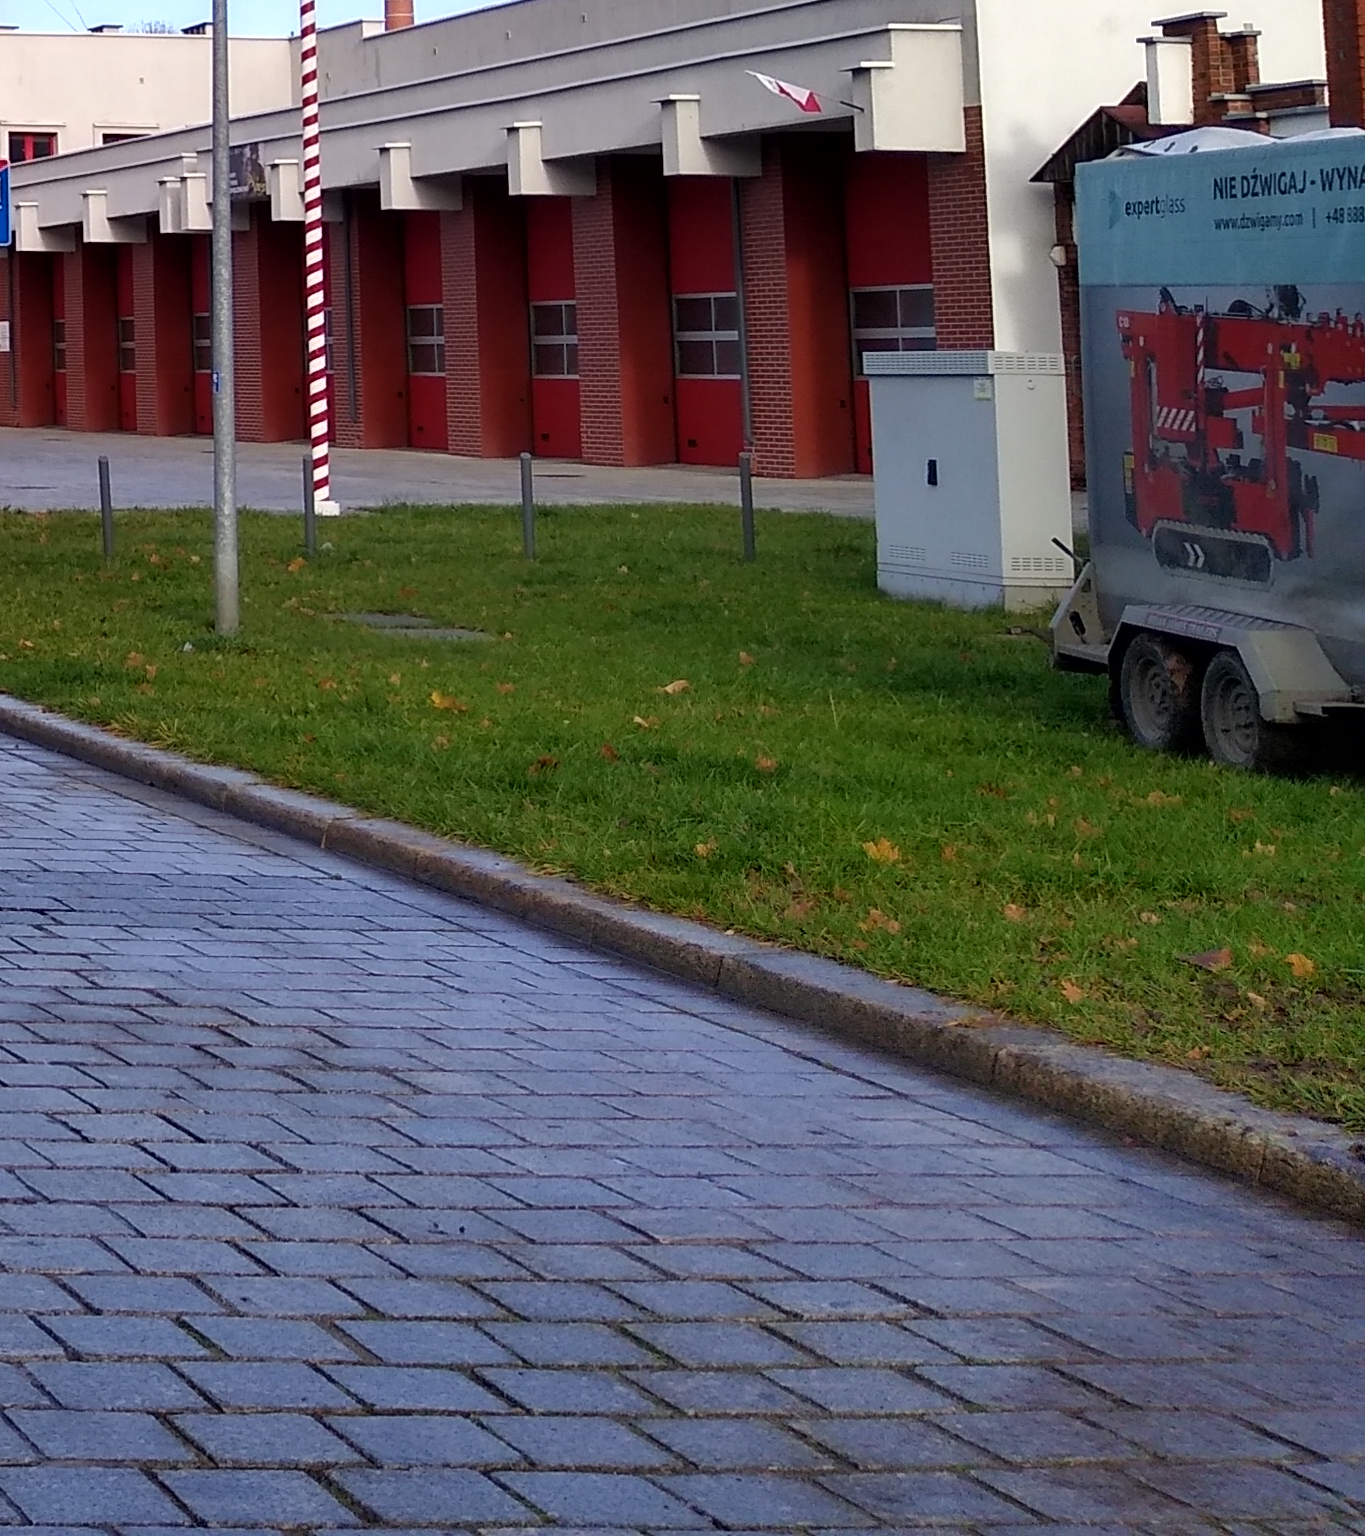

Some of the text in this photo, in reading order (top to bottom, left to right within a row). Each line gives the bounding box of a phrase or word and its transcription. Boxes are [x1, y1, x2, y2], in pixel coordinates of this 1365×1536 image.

[1213, 176, 1237, 200] NIE
[1240, 167, 1307, 198] DŹWIGAJ
[1125, 194, 1185, 220] expertglass
[1213, 212, 1303, 231] www.dzwigamy.com
[1325, 207, 1345, 224] +48
